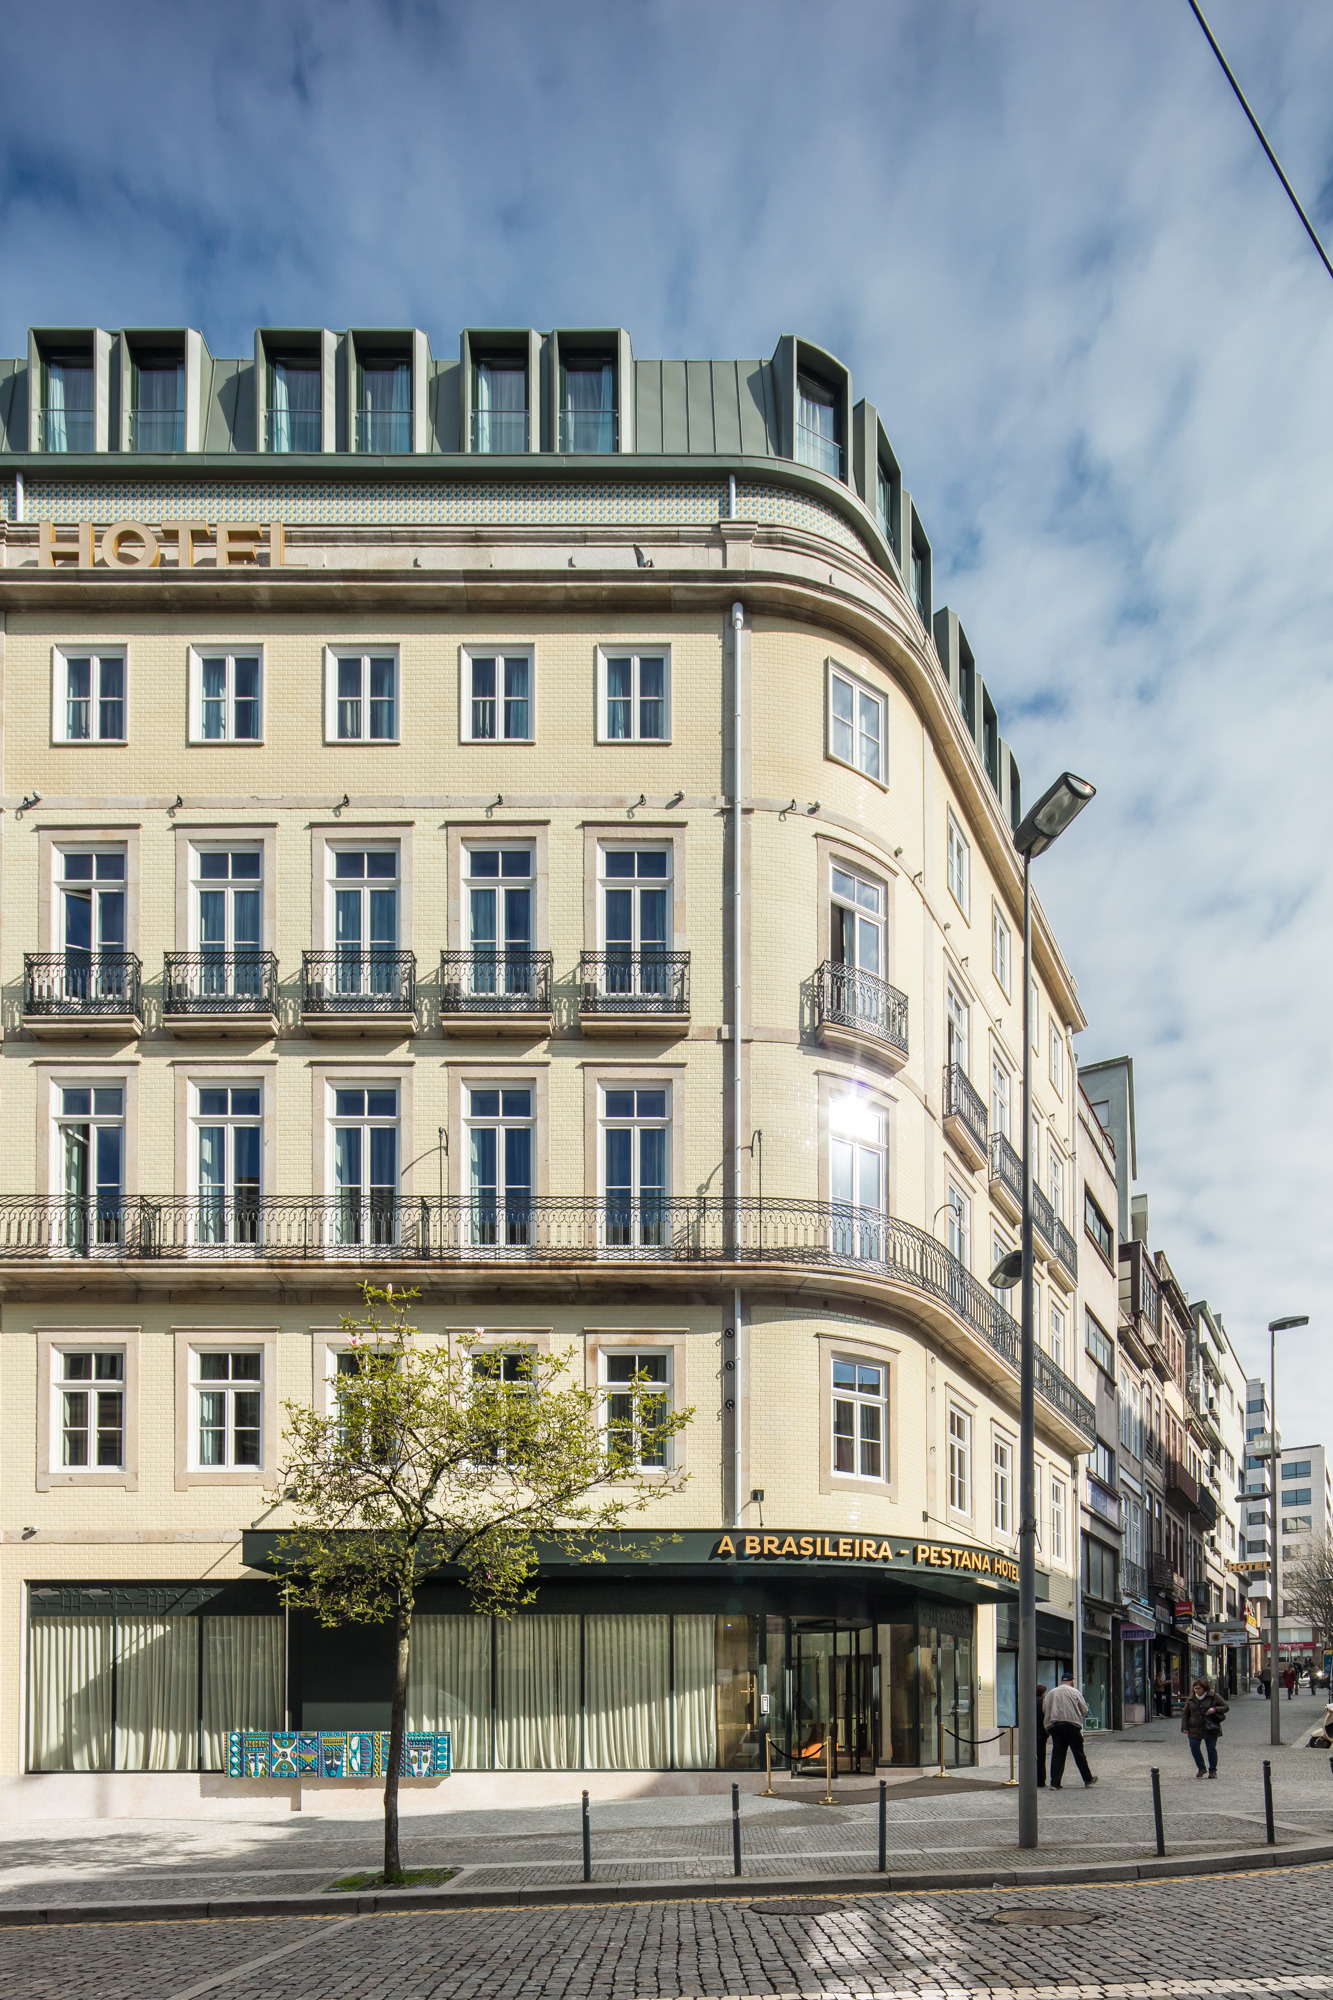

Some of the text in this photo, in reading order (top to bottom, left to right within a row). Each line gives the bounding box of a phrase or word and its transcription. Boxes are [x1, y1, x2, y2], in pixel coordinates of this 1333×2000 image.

[39, 520, 309, 568] HOTEL
[717, 1535, 736, 1554] A
[745, 1535, 893, 1560] BRASILEIRA
[916, 1544, 991, 1572] PESTANA
[994, 1556, 1020, 1582] HOTEL
[1228, 1561, 1271, 1572] HOTEL
